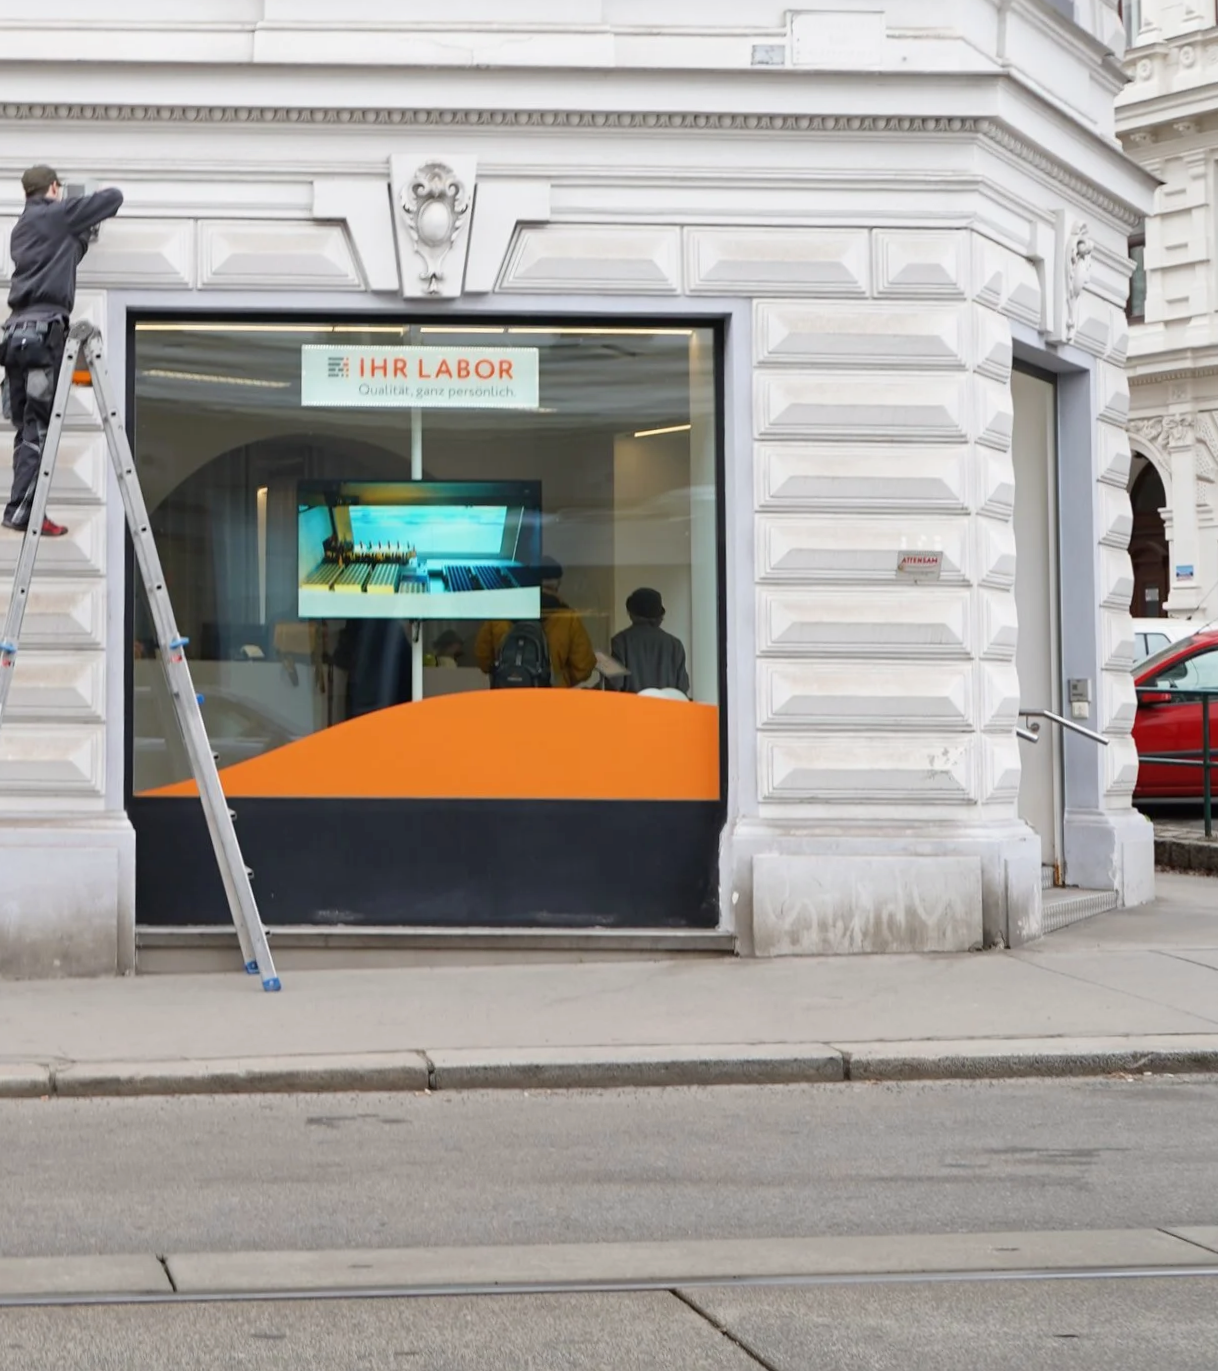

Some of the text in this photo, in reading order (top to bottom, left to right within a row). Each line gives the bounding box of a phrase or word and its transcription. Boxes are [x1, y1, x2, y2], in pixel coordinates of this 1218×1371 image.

[359, 357, 513, 380] IHR LABOR
[358, 382, 516, 399] Qualität, ganz persönlich.
